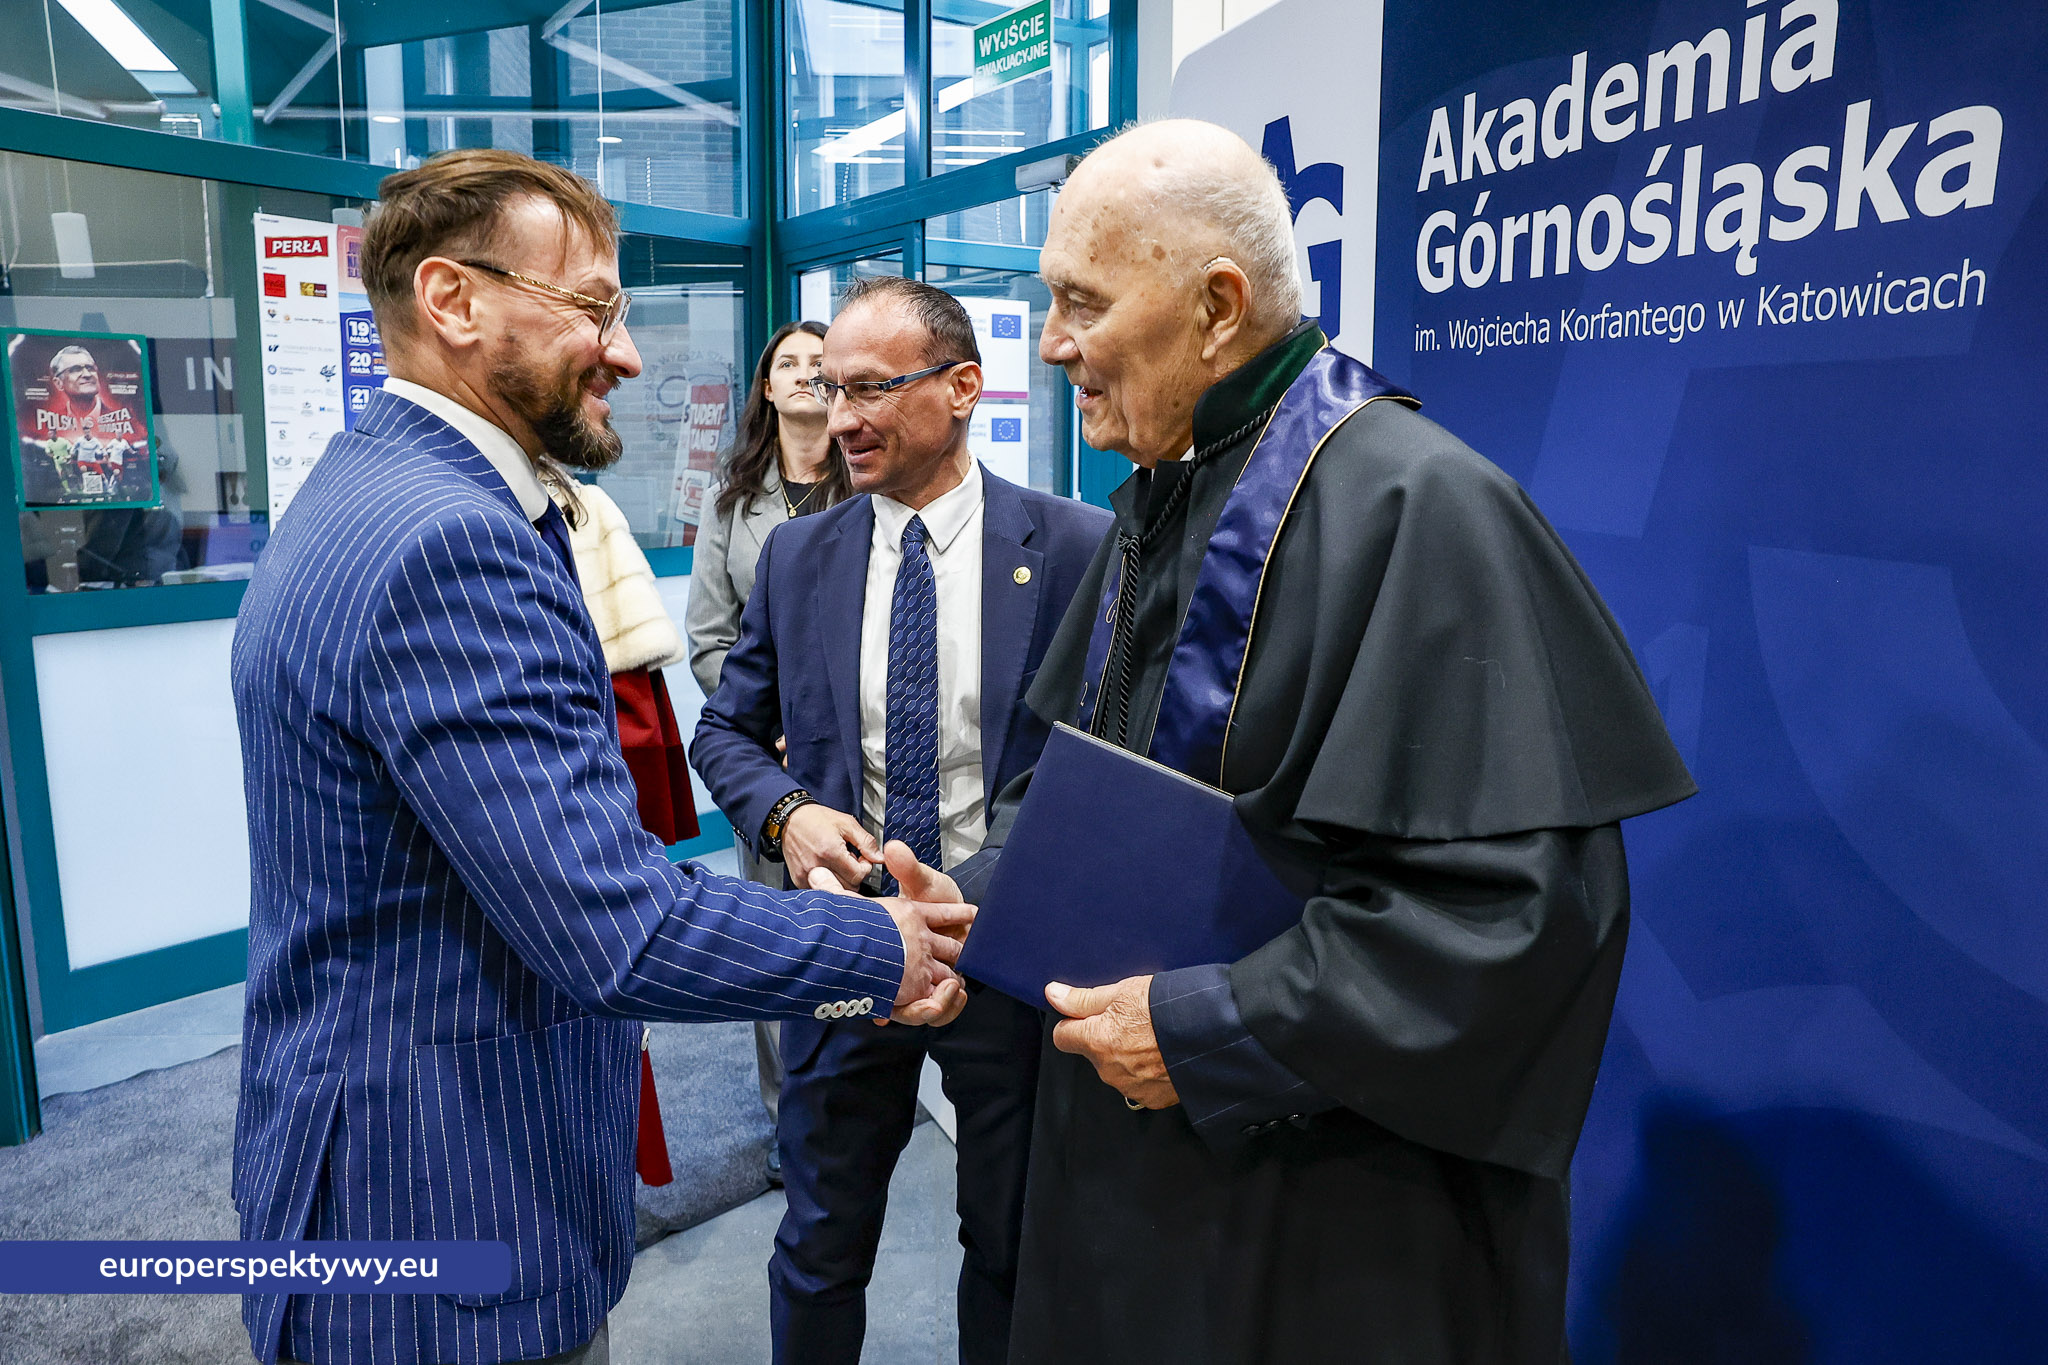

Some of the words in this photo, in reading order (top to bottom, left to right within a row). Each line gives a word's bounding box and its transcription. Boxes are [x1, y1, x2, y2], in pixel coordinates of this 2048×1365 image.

[979, 12, 1045, 57] WYJŚCIE
[975, 40, 1049, 77] EWAKUACYJNE
[1416, 0, 1839, 192] Akademia
[1416, 99, 2004, 294] Górnośląska
[272, 239, 323, 254] PERŁA
[1415, 322, 1441, 352] im.
[1447, 311, 1551, 356] Wojciecha
[1559, 297, 1705, 344] Korfantego
[1718, 297, 1744, 330] w
[1757, 258, 1988, 327] Katowicach
[349, 321, 369, 336] 19
[349, 352, 371, 367] 20
[351, 388, 370, 404] 21
